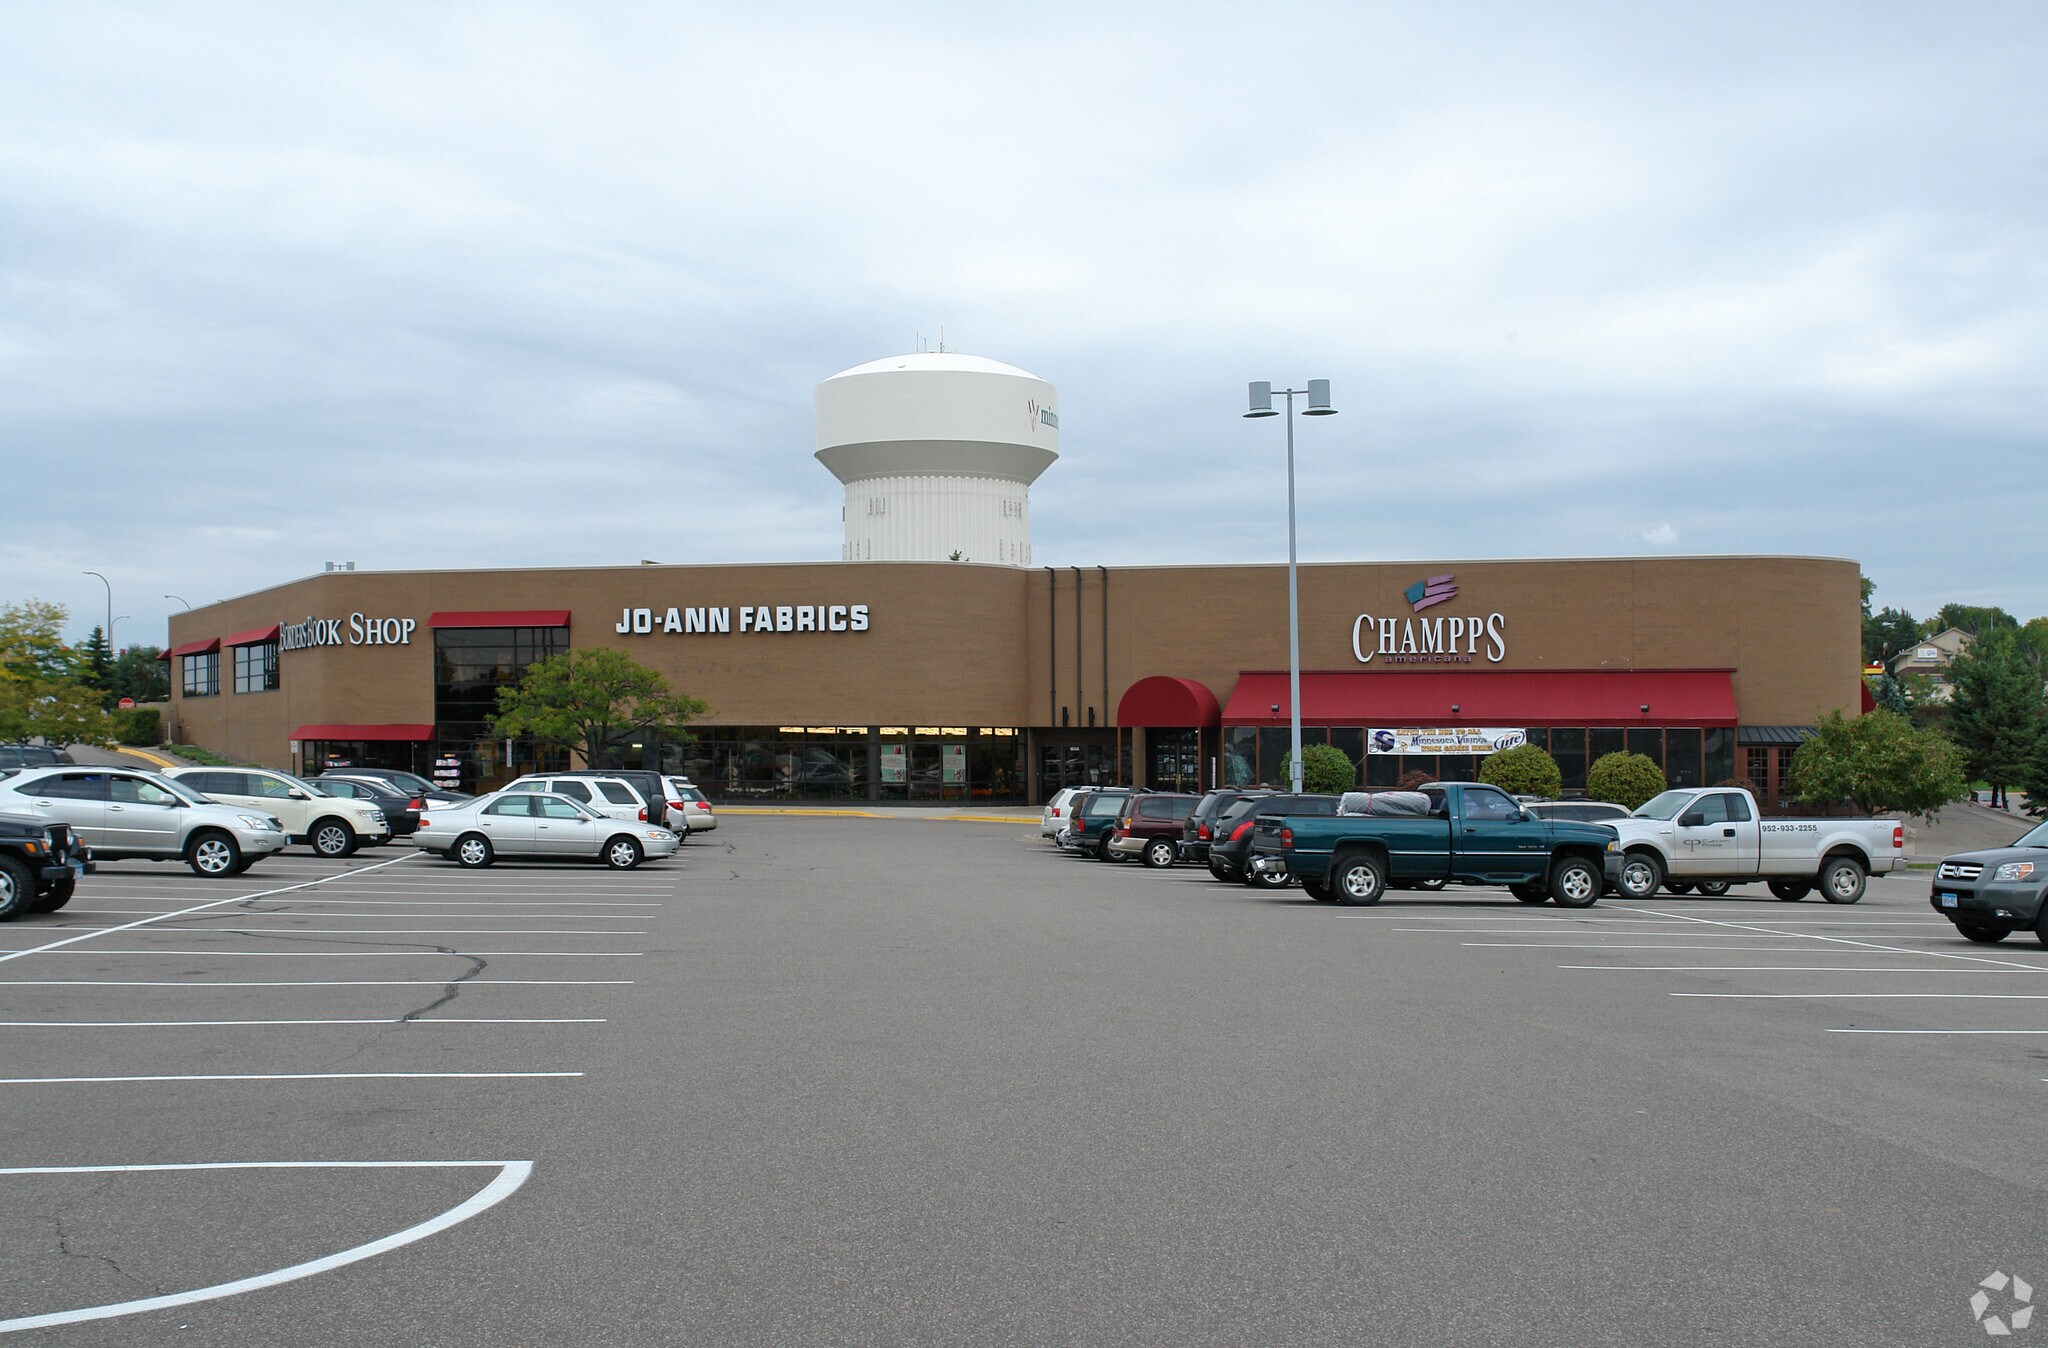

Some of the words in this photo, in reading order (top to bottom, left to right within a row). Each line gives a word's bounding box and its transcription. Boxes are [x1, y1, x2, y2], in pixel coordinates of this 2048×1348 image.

[280, 621, 307, 651] BORDERS
[307, 616, 342, 647] BOOK
[348, 612, 416, 645] SHOP
[615, 607, 731, 634] JO-ANN
[739, 605, 869, 632] FABRICS
[1352, 612, 1505, 663] CHAMPPS
[1384, 655, 1472, 663] americana
[1761, 824, 1818, 832] 952-933-2255
